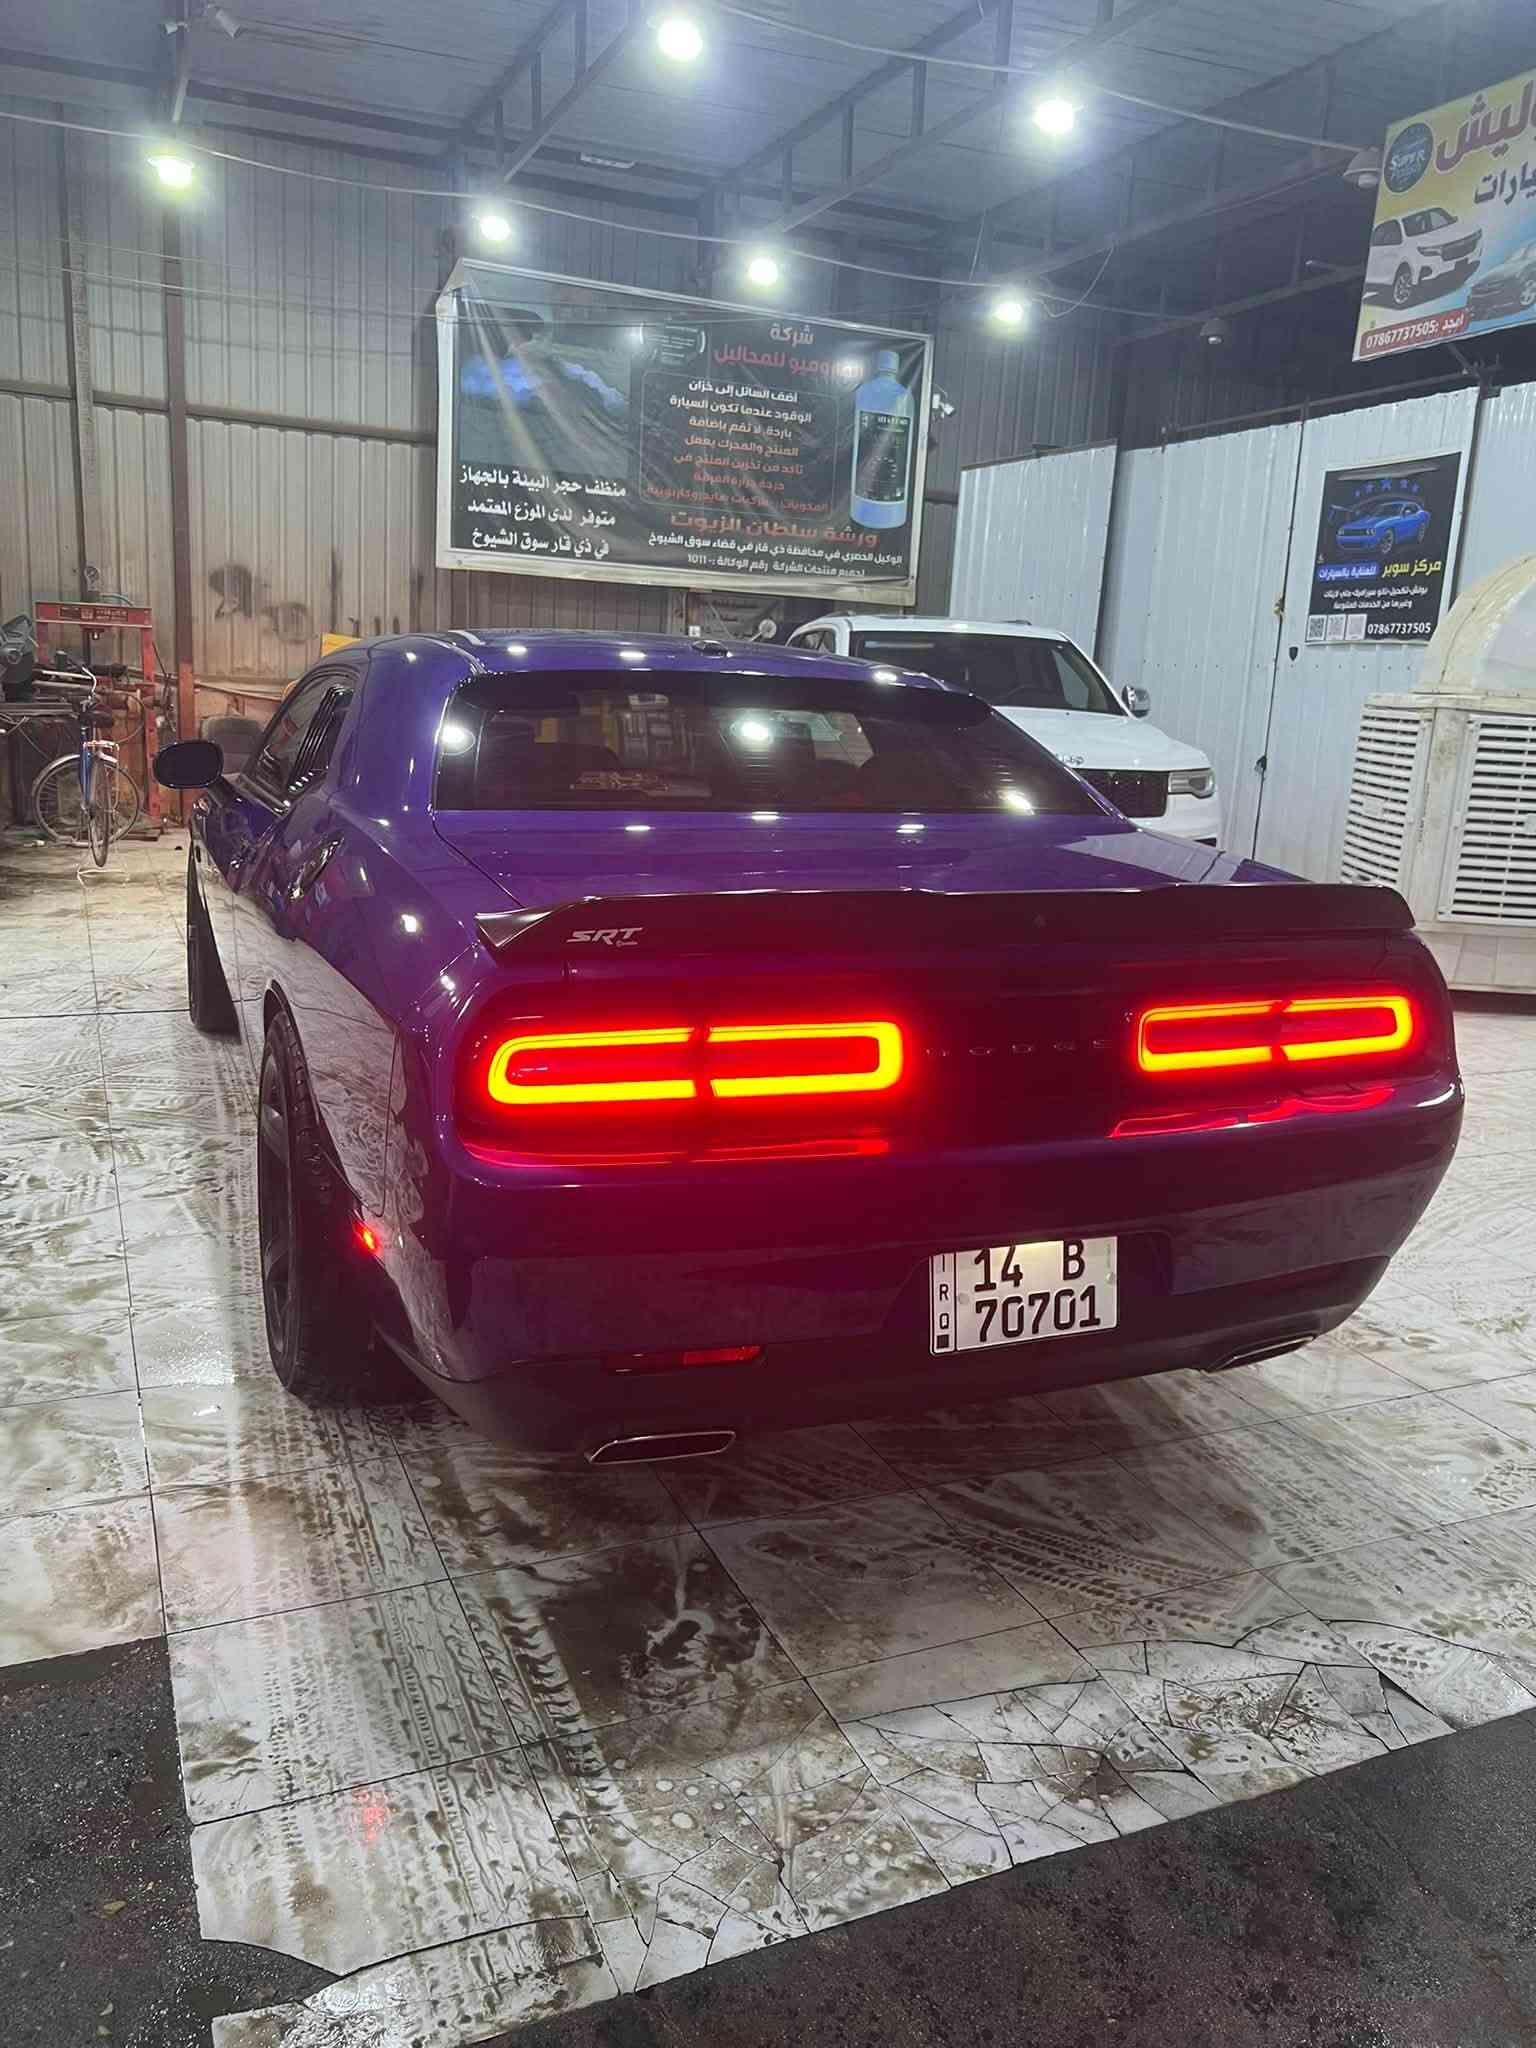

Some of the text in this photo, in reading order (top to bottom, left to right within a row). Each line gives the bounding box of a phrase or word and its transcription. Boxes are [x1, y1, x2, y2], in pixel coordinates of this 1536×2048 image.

[1436, 79, 1536, 172] ليش
[1475, 160, 1536, 206] يارات
[770, 322, 814, 347] شركة
[713, 344, 786, 367] للمحاليل
[688, 380, 714, 393] خزان
[670, 394, 812, 425] الوقود عندما تكون السيارة
[459, 464, 510, 488] بالجهاز
[552, 479, 583, 496] حجر
[585, 479, 627, 497] منظف
[467, 498, 512, 516] المعتمد
[514, 501, 545, 522] الموزع
[579, 508, 616, 529] متوفر
[670, 510, 880, 547] ورشة سلطان الزيوت
[471, 527, 518, 549] الشيوخ
[520, 531, 549, 551] سوق
[647, 530, 684, 547] الشيوخ
[684, 535, 711, 549] سوق
[873, 553, 903, 567] الوكيل
[1411, 558, 1442, 577] مركز
[1367, 622, 1431, 635] 07867737505
[566, 927, 643, 946] SRT
[974, 1241, 1024, 1293] 14
[1062, 1239, 1086, 1281] B
[974, 1285, 1101, 1343] 70701
